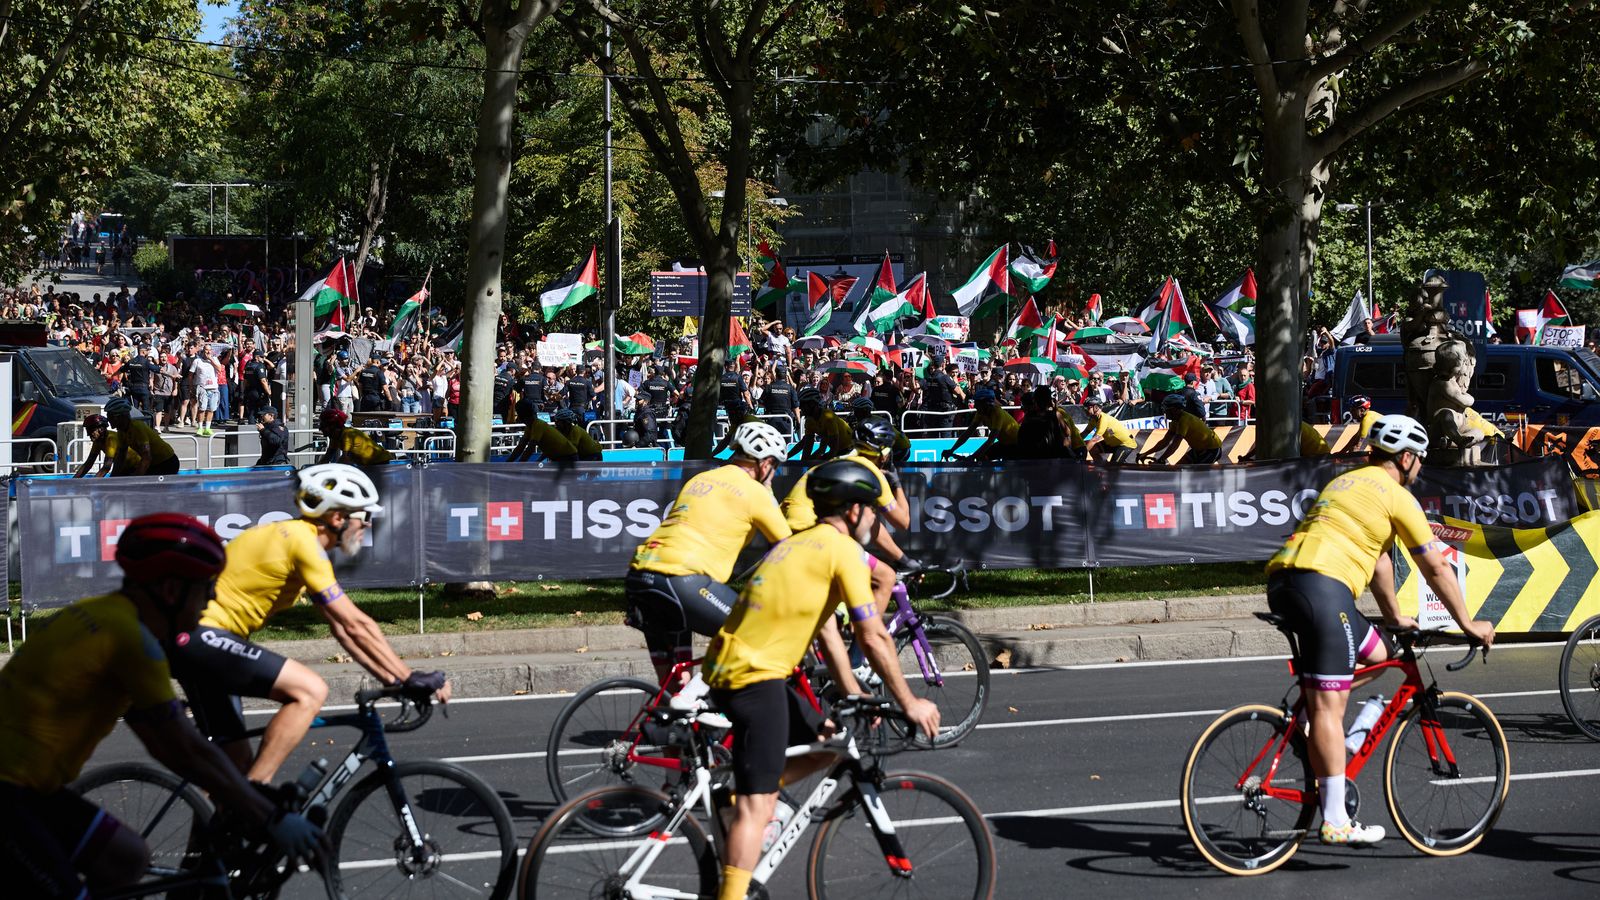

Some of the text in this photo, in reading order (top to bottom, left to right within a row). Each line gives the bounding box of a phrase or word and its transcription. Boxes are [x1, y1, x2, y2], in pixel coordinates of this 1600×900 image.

[1447, 320, 1483, 337] SSOT
[1544, 328, 1573, 338] STOP
[1544, 338, 1582, 347] GENOCIDE
[901, 351, 923, 368] PAZ
[936, 345, 946, 355] PAZ
[600, 467, 653, 478] OTERIAS
[531, 498, 674, 540] TISS
[908, 496, 1063, 533] ISSOT
[1115, 498, 1138, 526] T
[1181, 488, 1320, 528] TISSO
[1445, 488, 1558, 525] TISSOT
[450, 507, 479, 537] T
[59, 526, 91, 558] T
[1360, 688, 1409, 757] ORBEA
